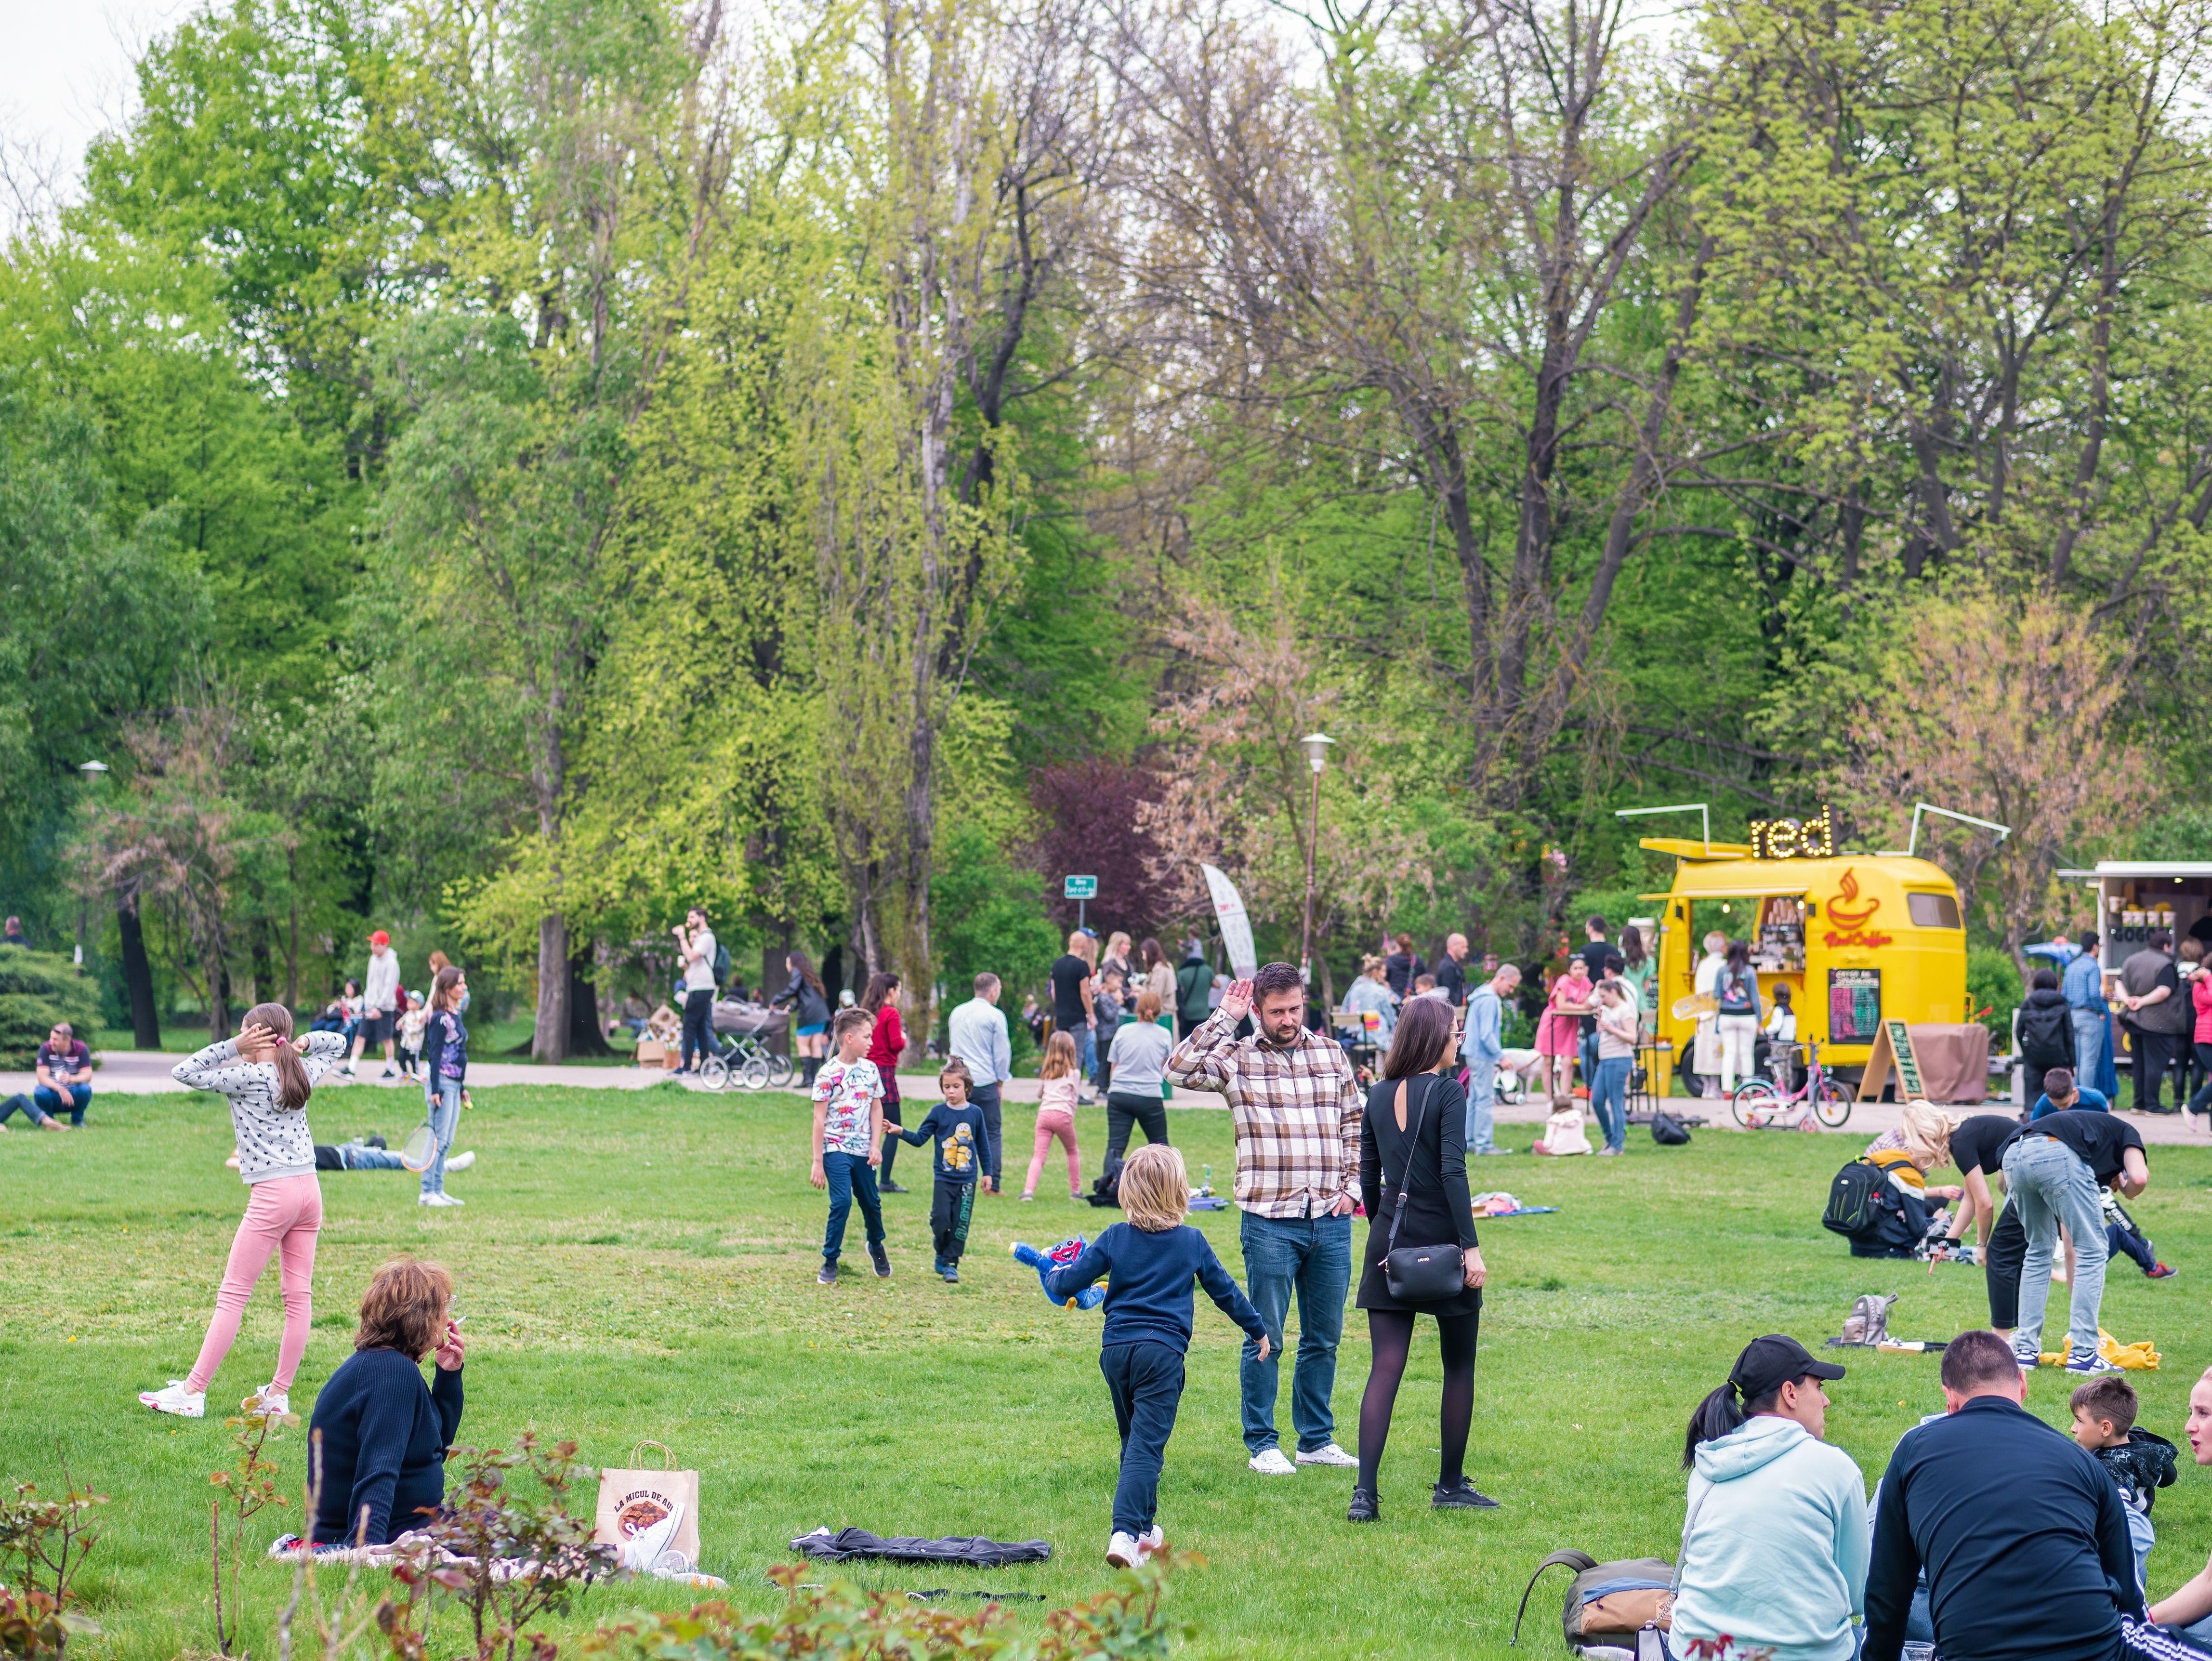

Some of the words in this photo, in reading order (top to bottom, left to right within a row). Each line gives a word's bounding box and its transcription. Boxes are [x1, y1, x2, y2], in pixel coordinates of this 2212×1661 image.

[1751, 804, 1833, 858] red
[614, 1500, 625, 1513] LA
[625, 1490, 649, 1503] MICUL
[651, 1491, 662, 1502] DE
